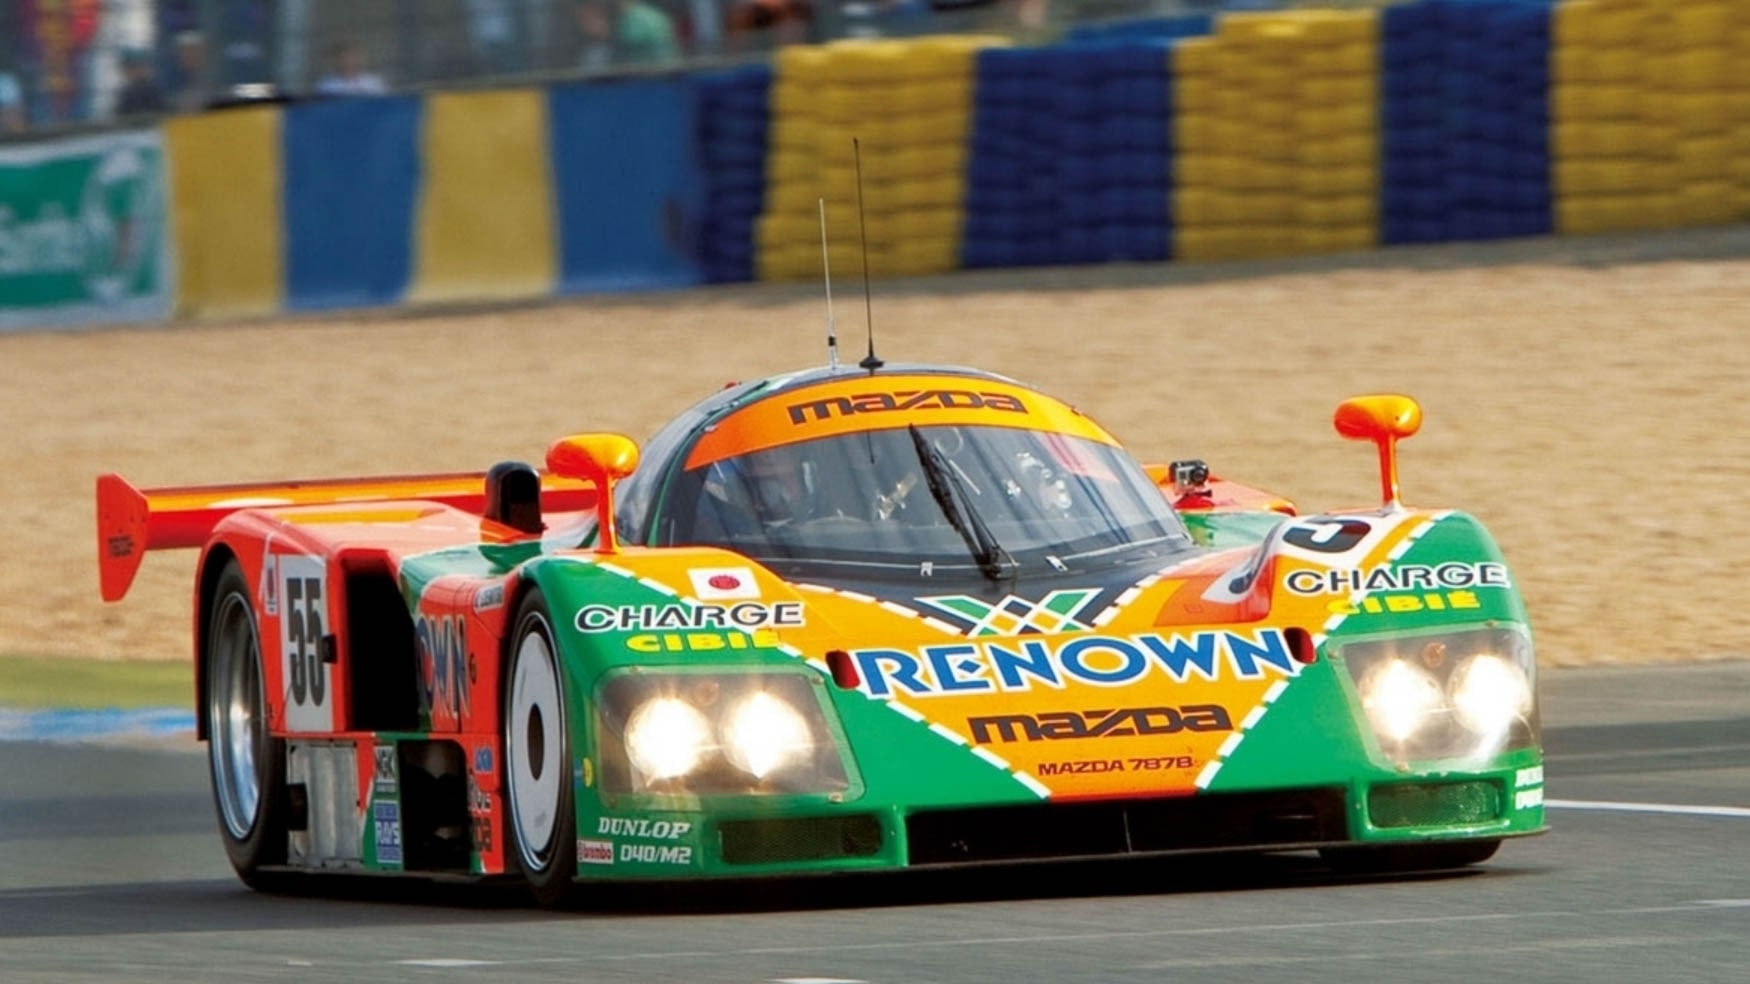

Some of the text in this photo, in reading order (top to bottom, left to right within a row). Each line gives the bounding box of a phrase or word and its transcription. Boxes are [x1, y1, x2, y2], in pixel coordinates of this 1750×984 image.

[1286, 564, 1507, 594] CHARGE
[576, 602, 802, 631] CHARGE
[286, 577, 325, 706] 55
[853, 629, 1297, 696] RENOWN
[1038, 756, 1194, 776] MAZDA 787B
[598, 816, 691, 839] DUNLOP
[620, 844, 692, 864] D40/M2
